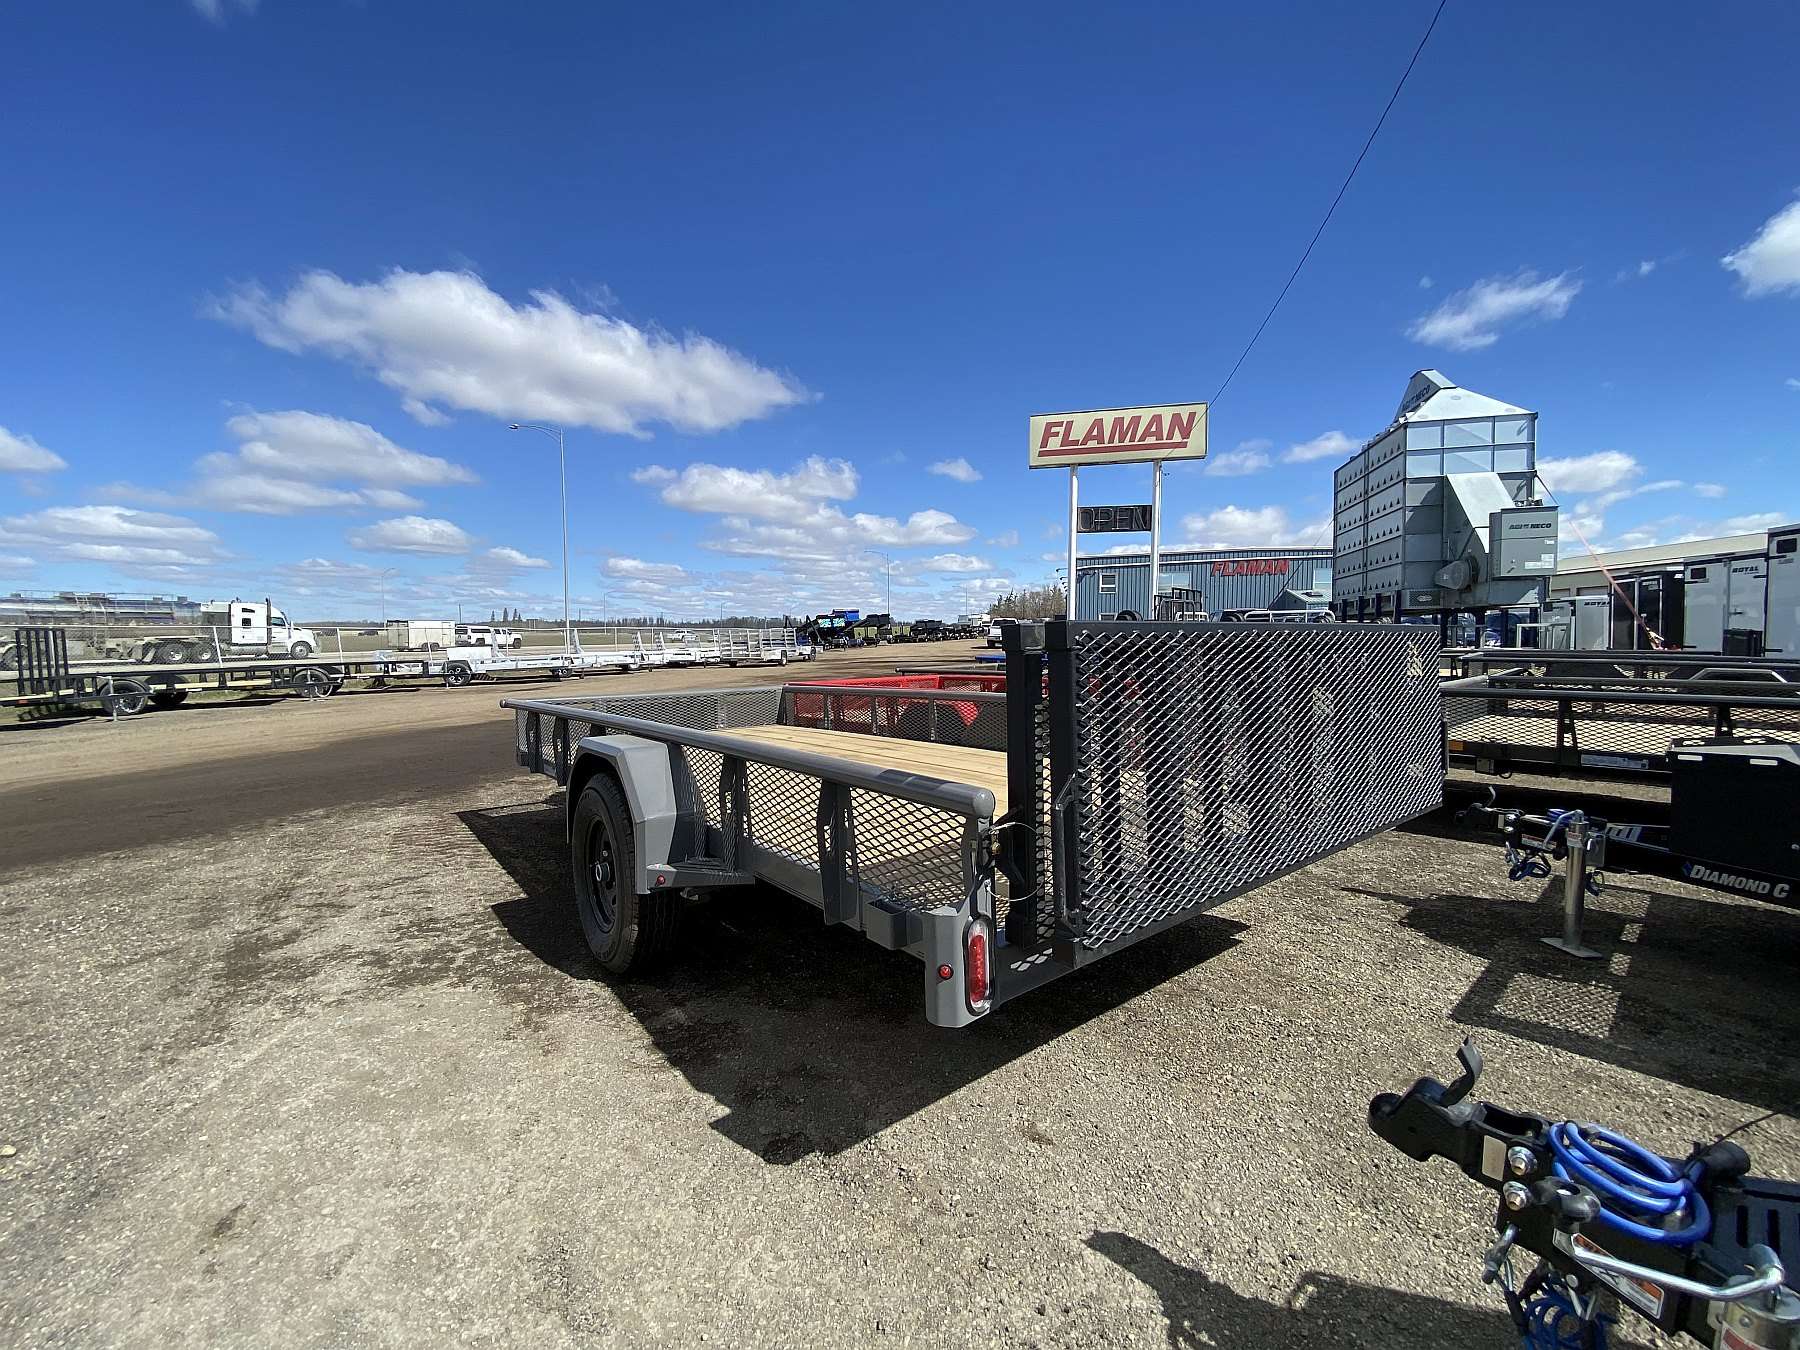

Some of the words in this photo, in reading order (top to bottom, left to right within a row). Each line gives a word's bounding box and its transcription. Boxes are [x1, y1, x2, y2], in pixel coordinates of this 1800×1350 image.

[1039, 411, 1197, 449] FLAMAN
[1079, 506, 1149, 531] OPEN
[1211, 560, 1289, 577] FLAMAN
[1732, 566, 1759, 574] ROYAL
[1690, 865, 1771, 894] DIAMOND
[1773, 883, 1790, 898] C
